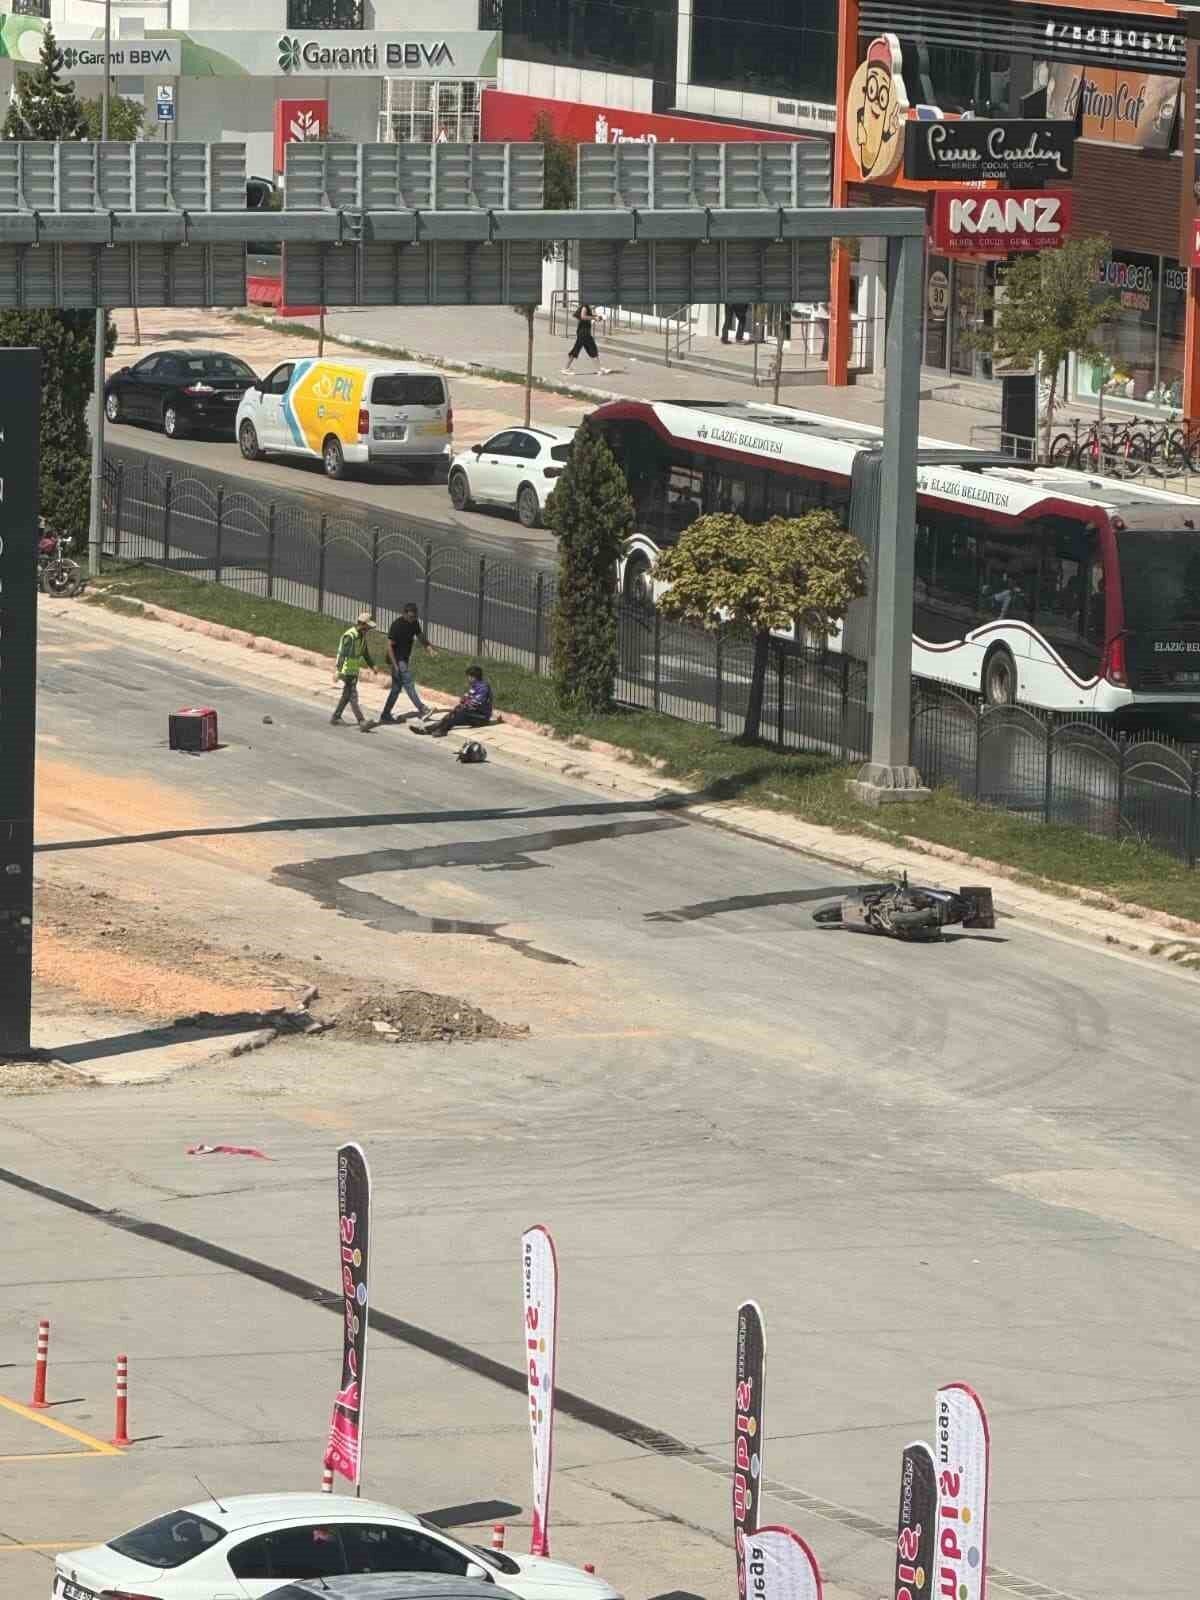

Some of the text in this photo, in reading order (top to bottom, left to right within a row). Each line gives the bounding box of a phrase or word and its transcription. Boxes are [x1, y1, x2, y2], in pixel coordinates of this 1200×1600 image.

[78, 49, 171, 65] Garanti BBVA
[302, 42, 456, 67] Garanti BBVA
[928, 124, 1069, 173] Pierre Cardin
[949, 197, 1061, 234] KANZ
[333, 376, 353, 402] Ptt
[738, 433, 785, 455] BELEDİYESİ
[930, 478, 1009, 508] ELAZIĞ BELEDİYESİ
